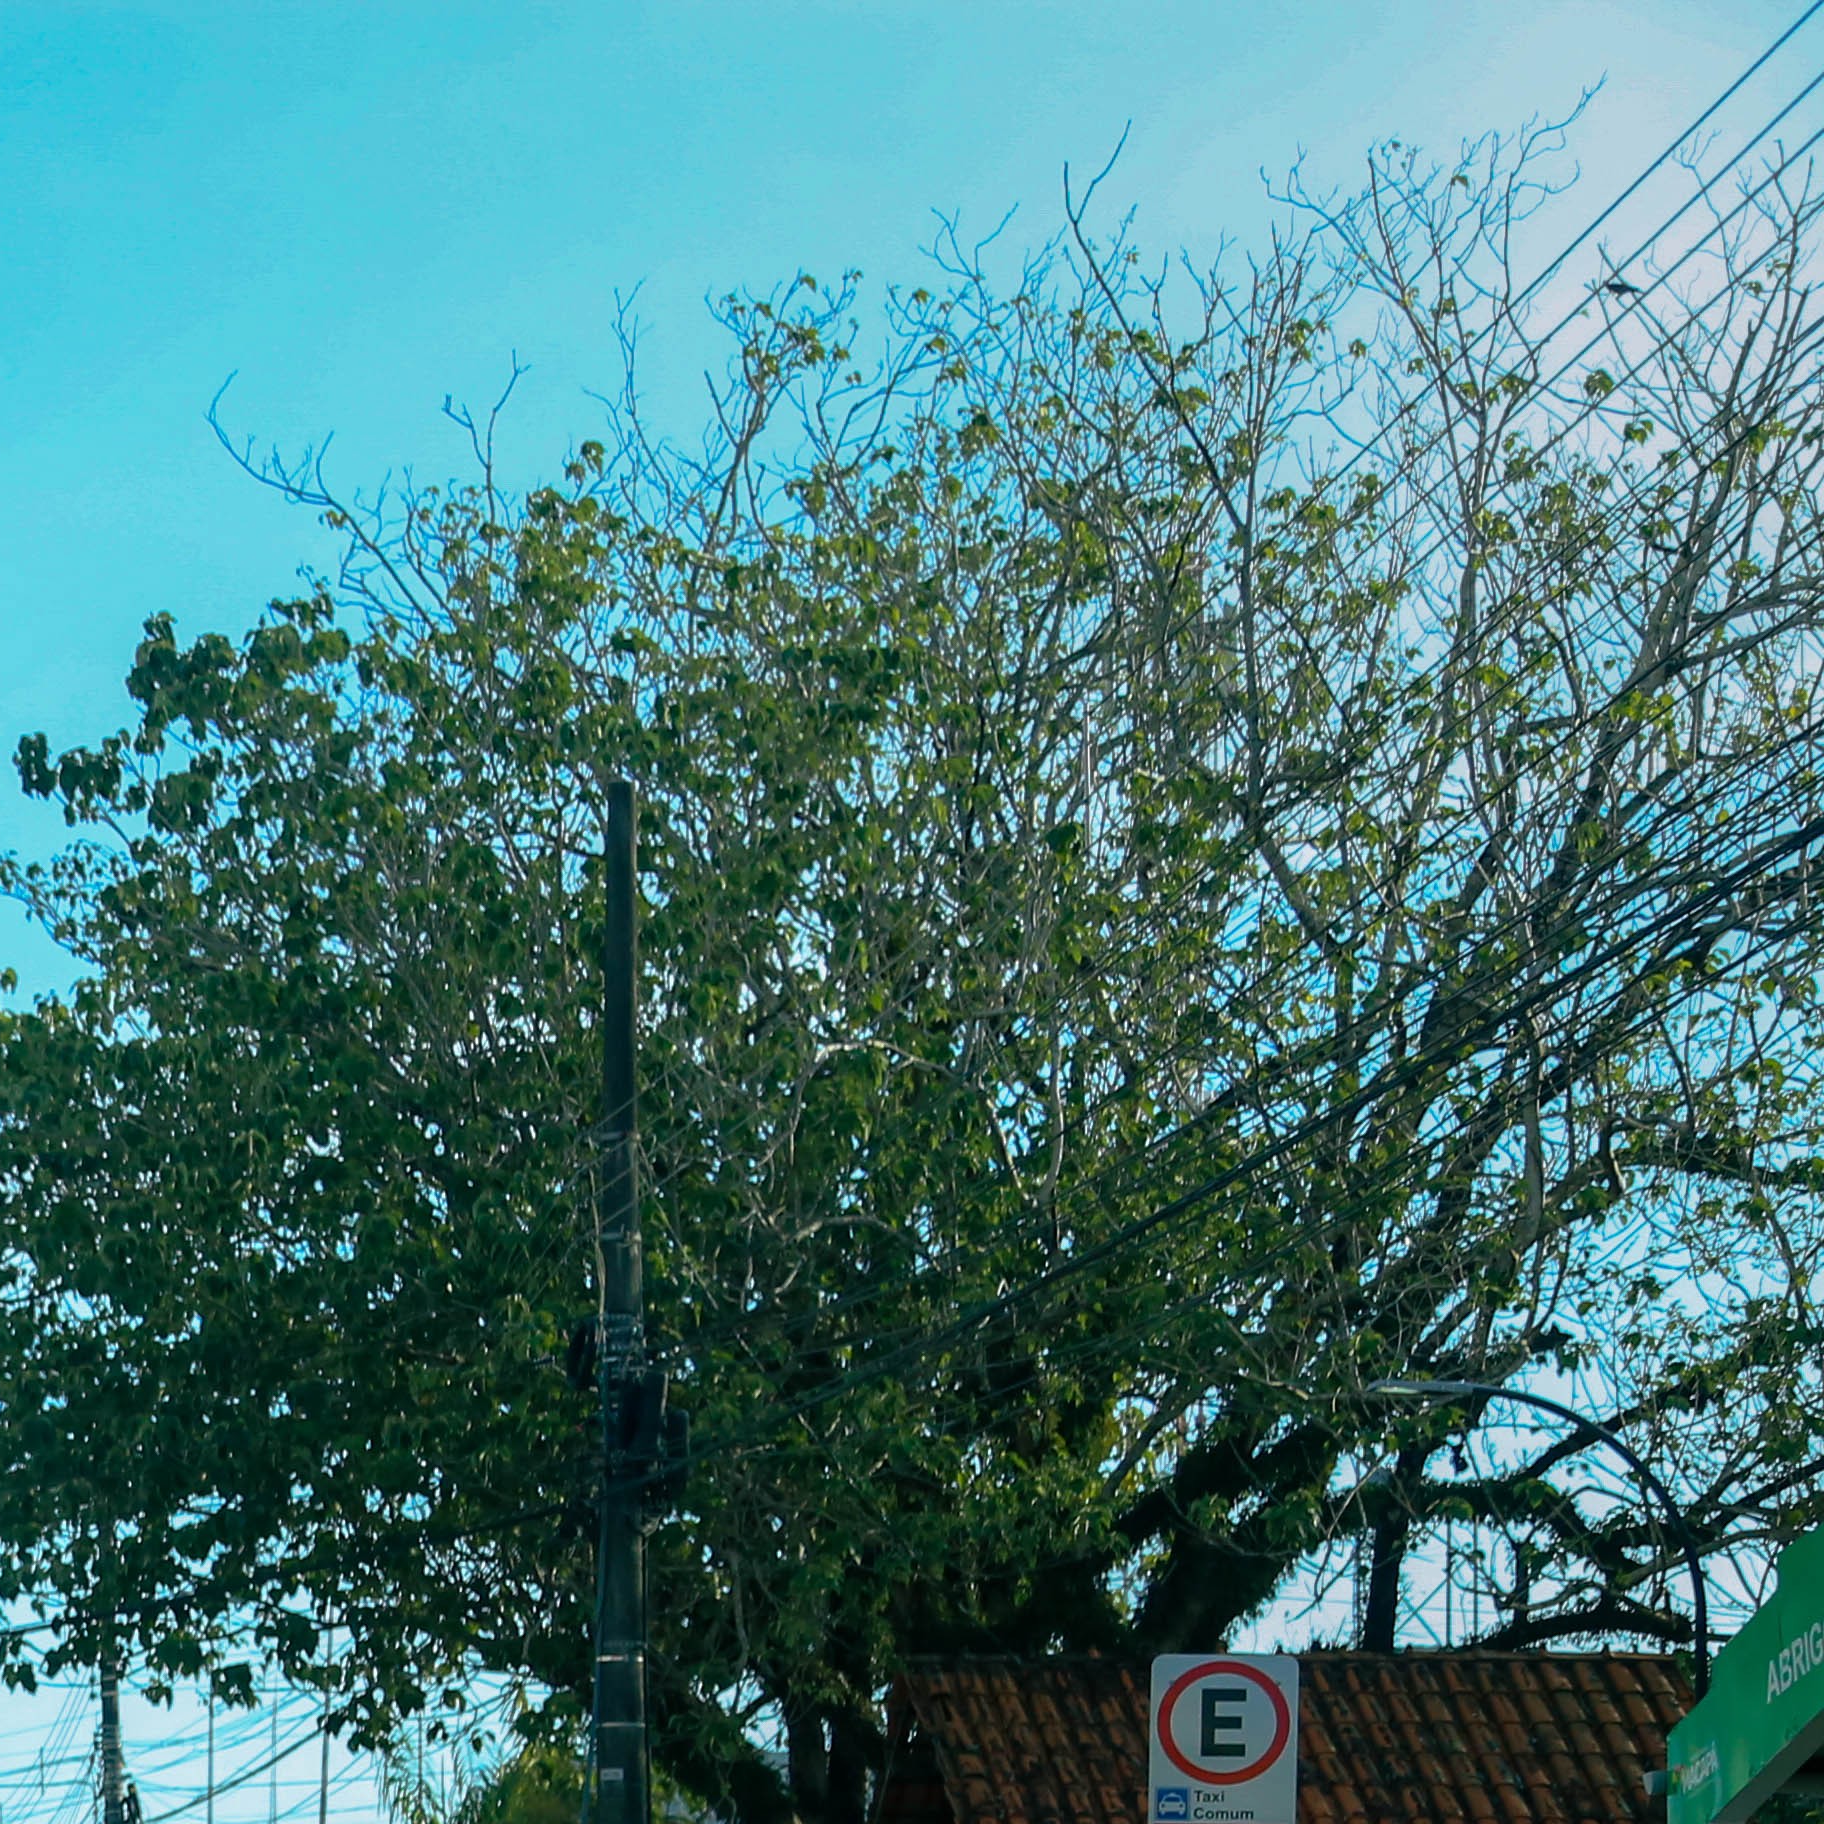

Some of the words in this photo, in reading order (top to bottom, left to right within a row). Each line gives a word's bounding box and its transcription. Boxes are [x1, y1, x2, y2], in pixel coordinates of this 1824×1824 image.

[1201, 1688, 1247, 1757] E
[1194, 1790, 1225, 1803] Taxi
[1194, 1807, 1254, 1820] Comum
